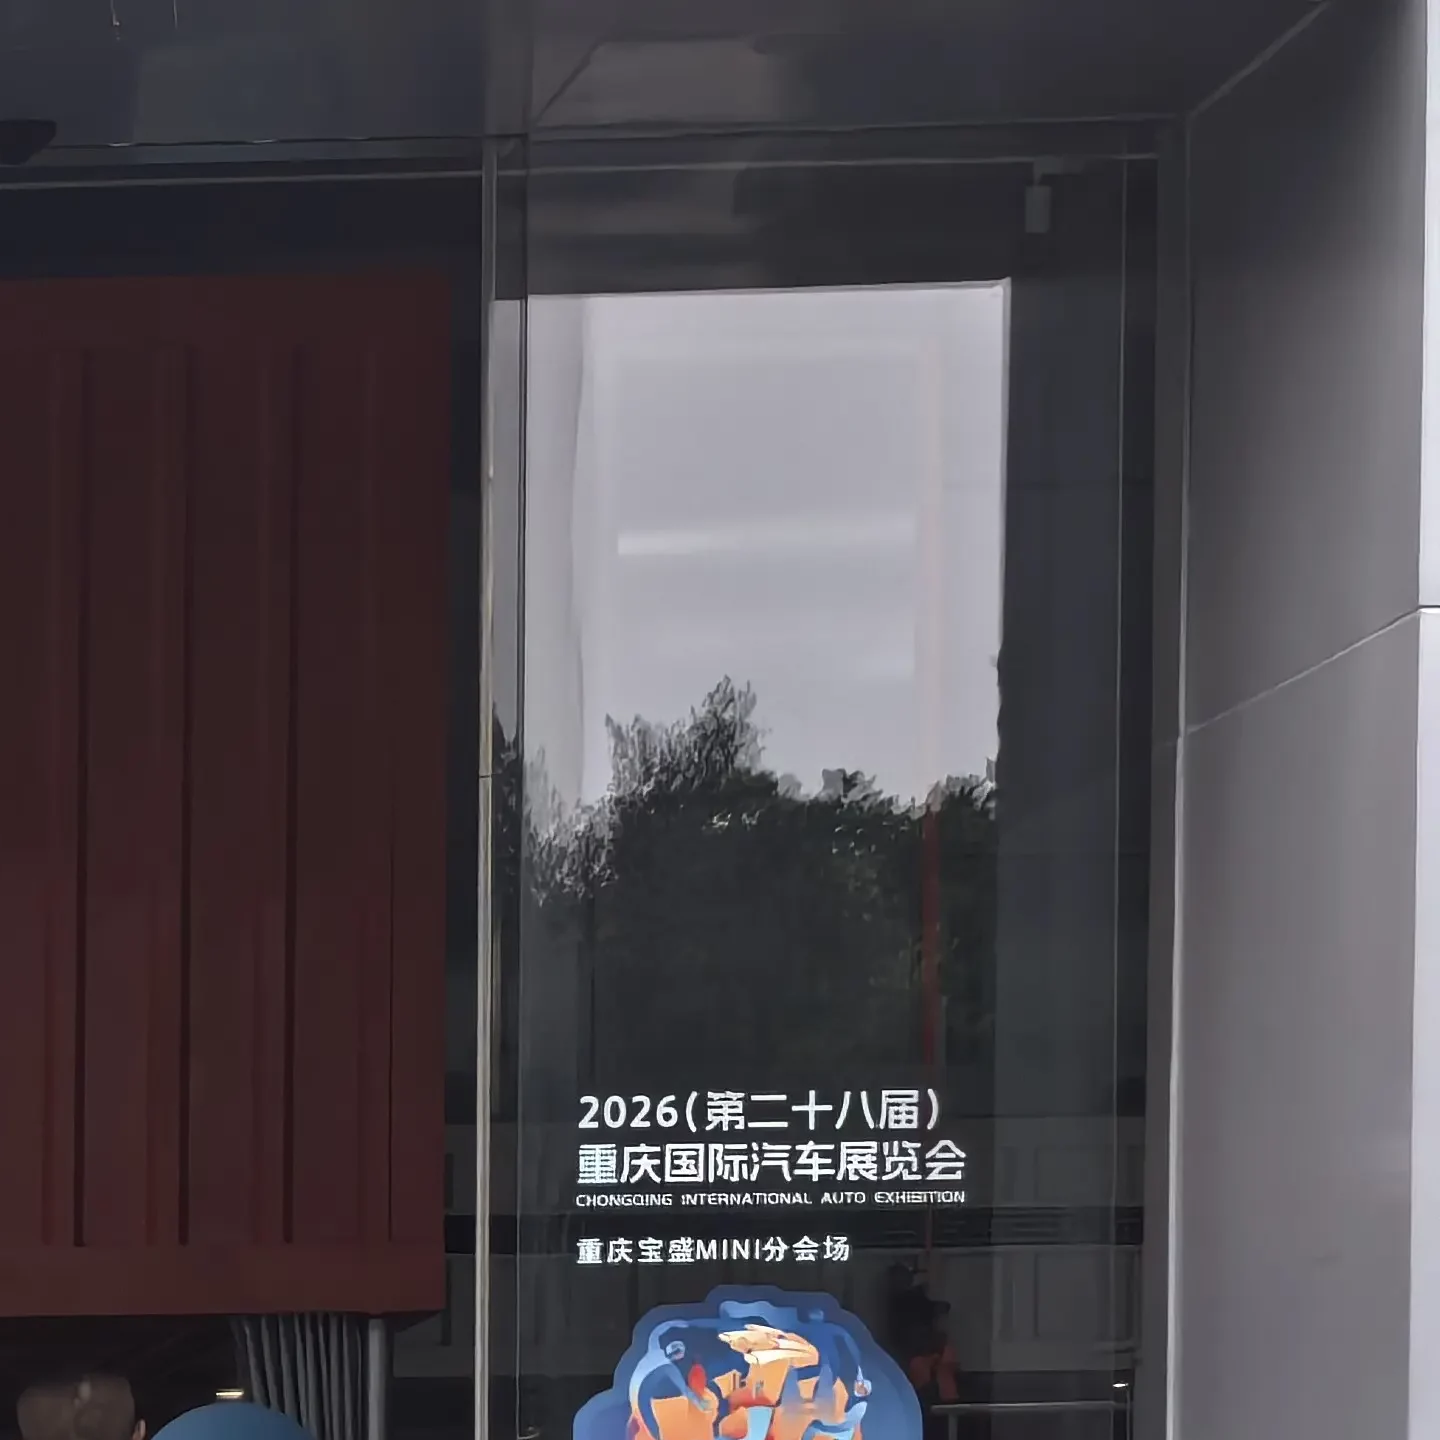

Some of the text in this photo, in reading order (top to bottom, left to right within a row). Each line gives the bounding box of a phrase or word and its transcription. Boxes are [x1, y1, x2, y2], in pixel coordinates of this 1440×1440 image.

[578, 1089, 940, 1133] 2026(第二十八届)
[577, 1139, 967, 1185] 重庆国际汽车展览会
[576, 1190, 966, 1207] CHONGQING INTERNATIONAL AUTO EXHIBITION
[576, 1236, 850, 1265] 重庆宝盛MINI分会场
